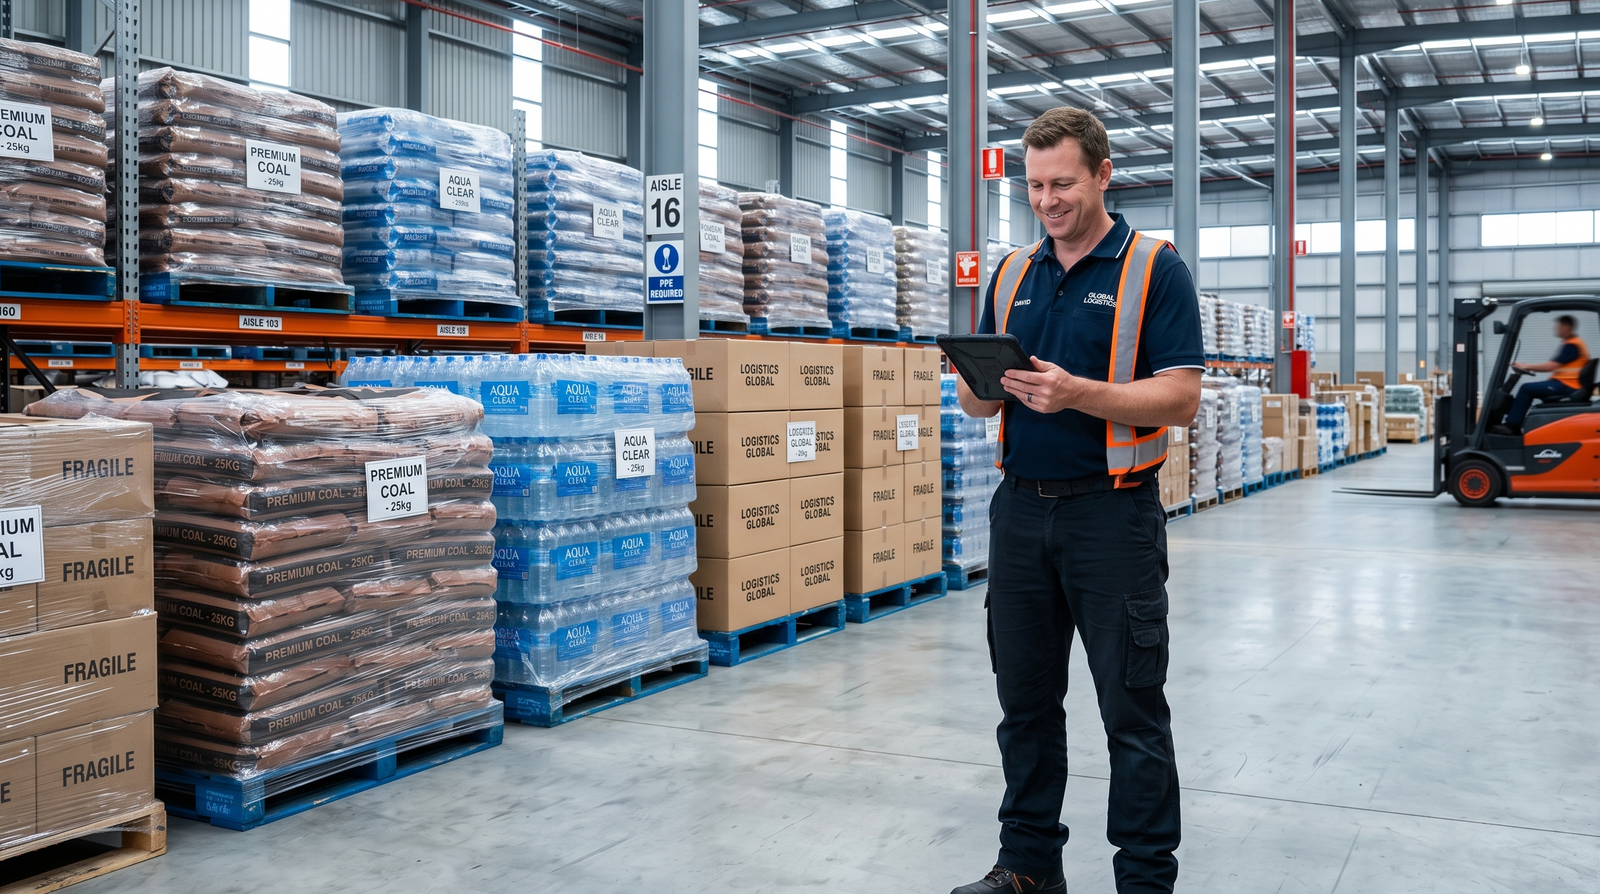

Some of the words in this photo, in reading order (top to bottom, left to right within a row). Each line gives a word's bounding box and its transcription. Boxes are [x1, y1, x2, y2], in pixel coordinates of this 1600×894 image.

[1, 109, 45, 125] EMIUM
[0, 124, 38, 141] OAL
[7, 142, 30, 154] 25kg
[251, 147, 296, 163] PREMIUM
[257, 161, 291, 176] COAL
[449, 175, 471, 186] AQUA
[651, 179, 681, 191] AISLE
[446, 186, 474, 198] CLEAR
[599, 208, 617, 218] AQUA
[651, 197, 680, 228] 16
[597, 217, 619, 227] CLEAR
[660, 279, 673, 287] PPE
[650, 289, 683, 298] REQUIRED
[1088, 292, 1115, 301] GLOBAL
[1014, 299, 1031, 307] DAVID
[1083, 297, 1117, 308] LOGISTICS
[243, 318, 264, 327] AISLE
[266, 320, 279, 328] 103
[440, 326, 455, 334] AISLE
[687, 367, 713, 380] GILE
[740, 364, 779, 375] LOGISTICS
[800, 365, 834, 375] LOGISTICS
[873, 370, 895, 381] FRAGILE
[745, 376, 774, 386] GLOBAL
[805, 376, 830, 386] GLOBAL
[913, 371, 933, 381] FRAGILE
[490, 385, 519, 396] AQUA
[565, 384, 591, 395] AQUA
[492, 396, 516, 404] CLEAR
[741, 435, 780, 447] LOGISTICS
[816, 431, 834, 441] STICS
[873, 429, 895, 441] FRAGILE
[624, 436, 648, 447] AQUA
[791, 438, 812, 447] GLOBAL
[622, 449, 650, 461] CLEAR
[746, 447, 775, 458] GLOBAL
[182, 454, 207, 466] COAL
[215, 458, 240, 471] 25KG
[669, 458, 689, 469] AQUA
[62, 458, 134, 480] FRAGILE
[371, 464, 422, 482] PREMIUM
[493, 466, 520, 478] AQUA
[565, 465, 591, 477] AQUA
[445, 478, 465, 488] COAL
[495, 478, 516, 486] CLEAR
[381, 482, 415, 498] COAL
[873, 489, 895, 502] FRAGILE
[913, 483, 934, 496] FRAGILE
[267, 491, 316, 508] PREMIUM
[318, 488, 345, 500] COAL
[801, 496, 834, 510] LOGISTICS
[391, 501, 412, 512] 25kg
[741, 504, 780, 519] LOGISTICS
[805, 508, 831, 520] GLOBAL
[746, 516, 775, 530] GLOBAL
[182, 529, 206, 542] COAL
[213, 534, 237, 548] 25KG
[669, 529, 688, 541] AQUA
[621, 537, 644, 550] AQUA
[913, 539, 934, 554] FRAGILE
[406, 547, 446, 559] PREMIUM
[447, 546, 469, 556] COAL
[494, 549, 519, 560] AQUA
[565, 546, 590, 560] AQUA
[873, 548, 895, 564] FRAGILE
[63, 555, 134, 582] FRAGILE
[266, 566, 314, 585] PREMIUM
[316, 561, 343, 574] COAL
[351, 555, 374, 568] 25KG
[495, 560, 515, 568] CLEAR
[801, 561, 834, 577] LOGISTICS
[741, 573, 780, 591] LOGISTICS
[805, 573, 830, 587] GLOBAL
[746, 587, 775, 602] GLOBAL
[669, 601, 689, 613] AQUA
[180, 605, 204, 620] COAL
[211, 612, 235, 627] 25KG
[449, 612, 470, 623] COAL
[565, 625, 591, 641] AQUA
[265, 640, 313, 663] PREMIUM
[316, 634, 343, 648] COAL
[568, 638, 586, 648] CLEAR
[64, 652, 136, 684] FRAGILE
[180, 679, 204, 693] COAL
[212, 687, 237, 702] 25KG
[268, 707, 316, 732] PREMIUM
[318, 701, 344, 715] COAL
[180, 750, 206, 765] COAL
[62, 750, 135, 787] FRAGILE
